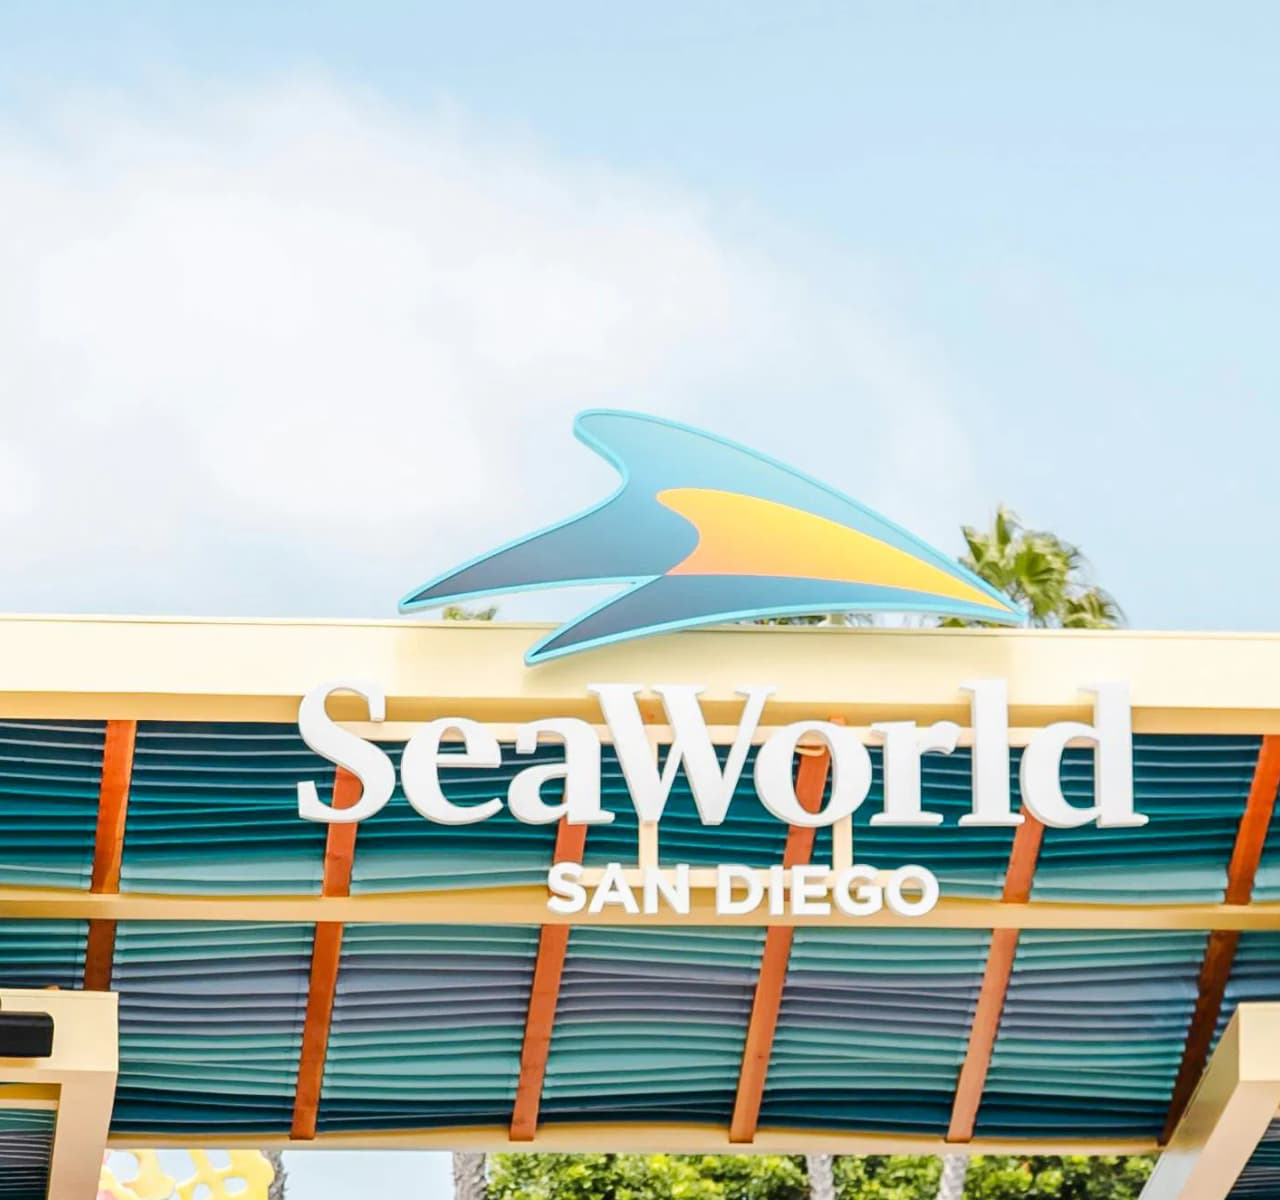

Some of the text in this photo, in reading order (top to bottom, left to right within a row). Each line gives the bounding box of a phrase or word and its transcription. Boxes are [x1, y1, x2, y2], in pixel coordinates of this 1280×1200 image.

[297, 679, 1149, 829] SeaWorld
[547, 861, 940, 917] SAN DIEGO
